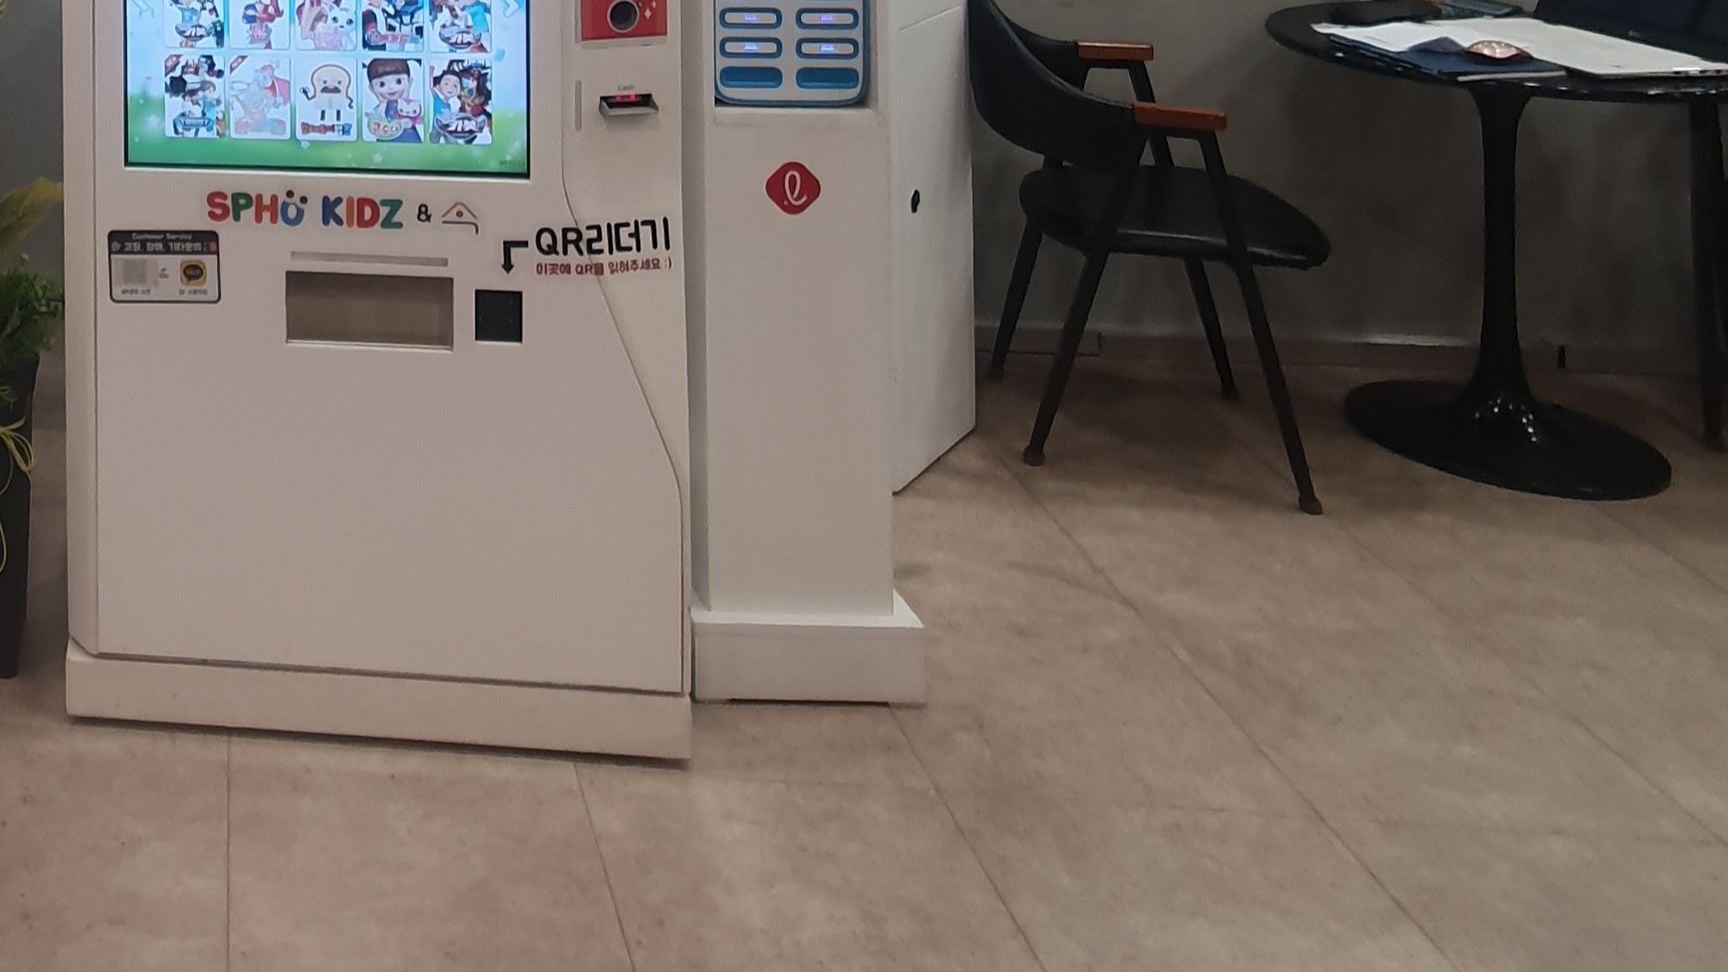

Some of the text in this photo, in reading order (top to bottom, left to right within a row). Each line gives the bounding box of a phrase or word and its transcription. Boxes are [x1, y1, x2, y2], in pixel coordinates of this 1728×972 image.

[321, 194, 404, 230] KIDZ
[416, 203, 432, 223] &
[535, 216, 671, 256] QR리더기
[536, 262, 571, 276] 이곳에
